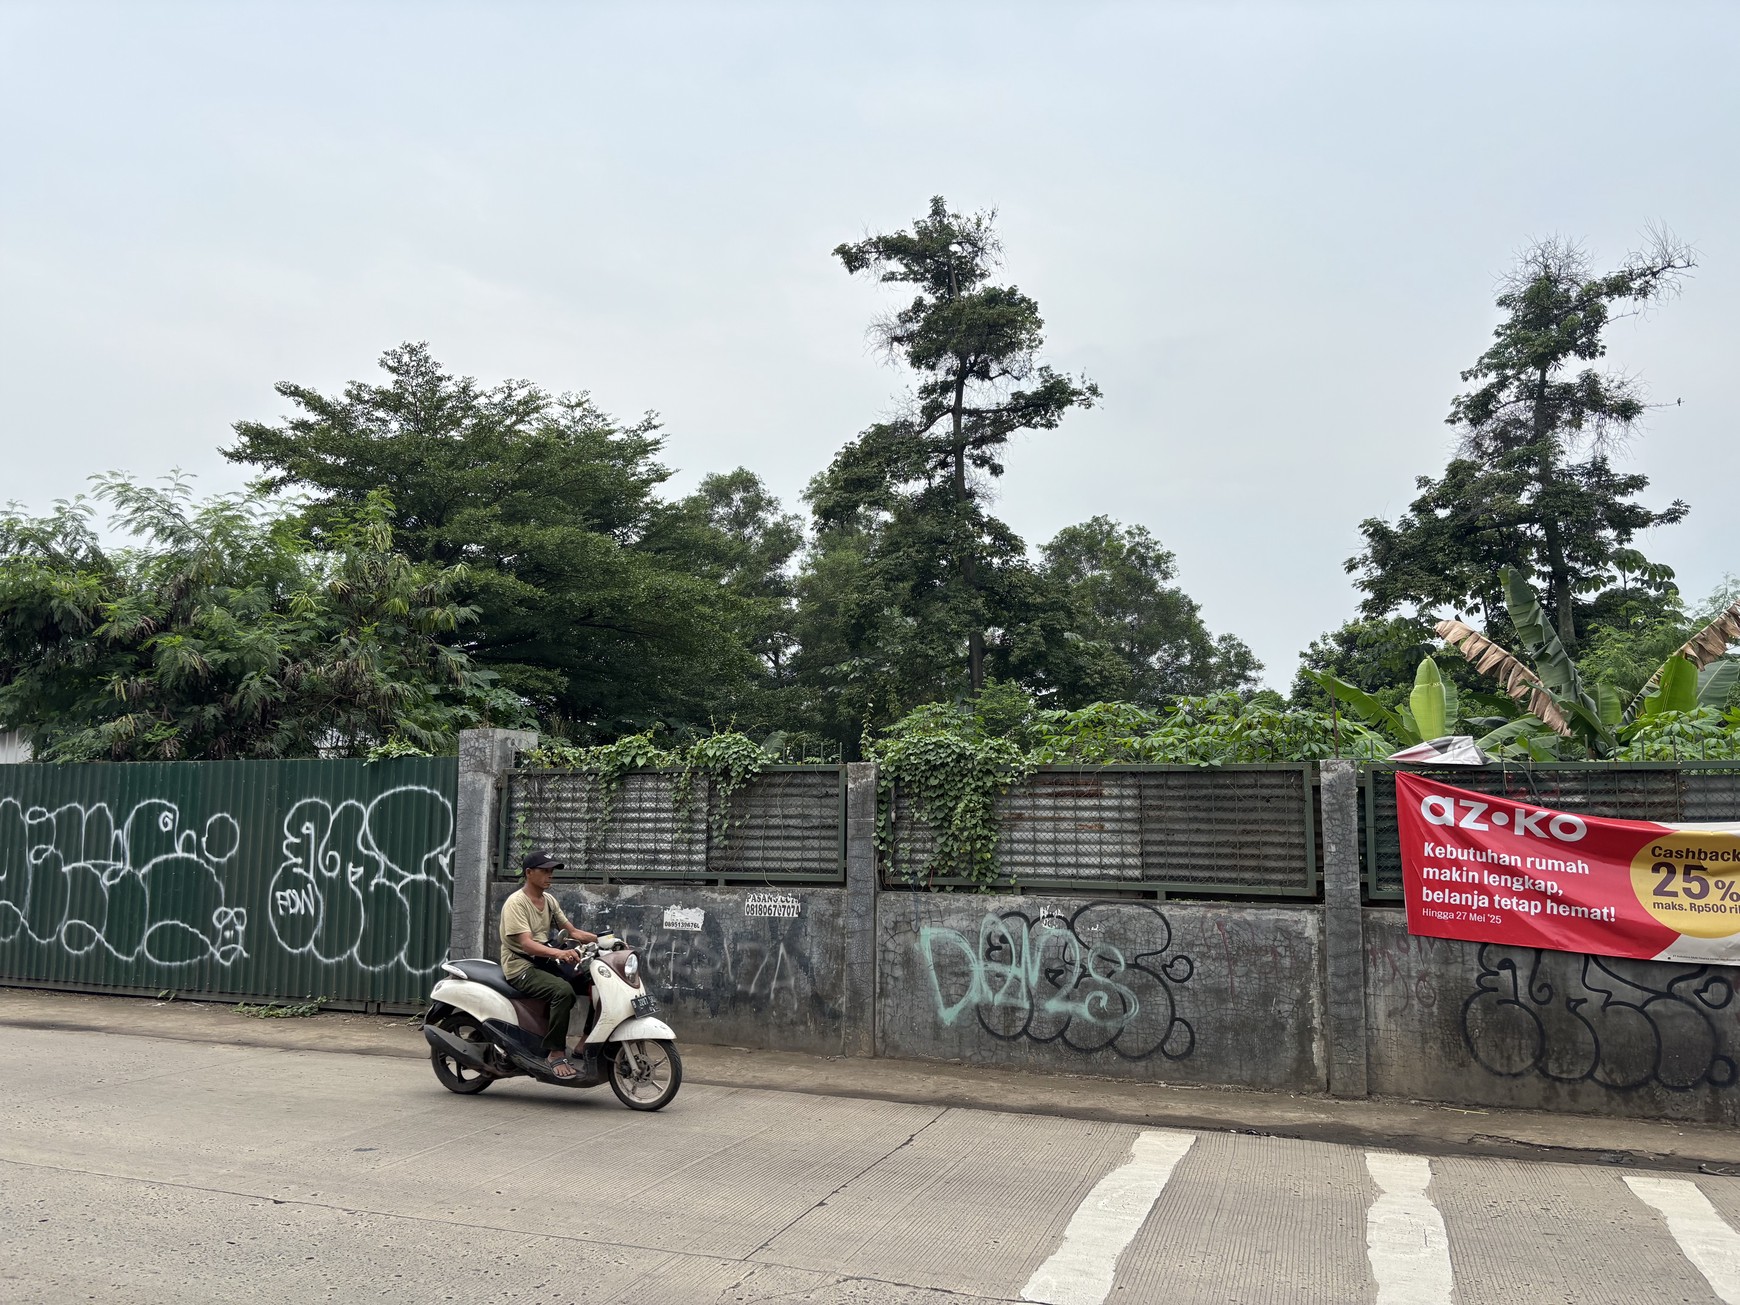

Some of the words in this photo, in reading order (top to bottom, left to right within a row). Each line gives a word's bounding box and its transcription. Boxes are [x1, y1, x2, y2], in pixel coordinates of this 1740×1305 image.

[1424, 842, 1522, 867] Kebutuhan
[1526, 855, 1590, 875] rumah
[1651, 846, 1740, 862] Cashback
[1423, 865, 1479, 884] makin
[1483, 870, 1564, 897] lengkap,
[1651, 861, 1740, 902] 25%
[1422, 887, 1489, 910] belanja
[1493, 893, 1542, 916] tetap
[1546, 899, 1616, 922] hemat!
[1422, 908, 1454, 920] Hingga
[1456, 911, 1467, 920] 27
[1469, 912, 1486, 923] Mei
[1653, 901, 1688, 911] maks.
[1689, 902, 1727, 914] Rp500
